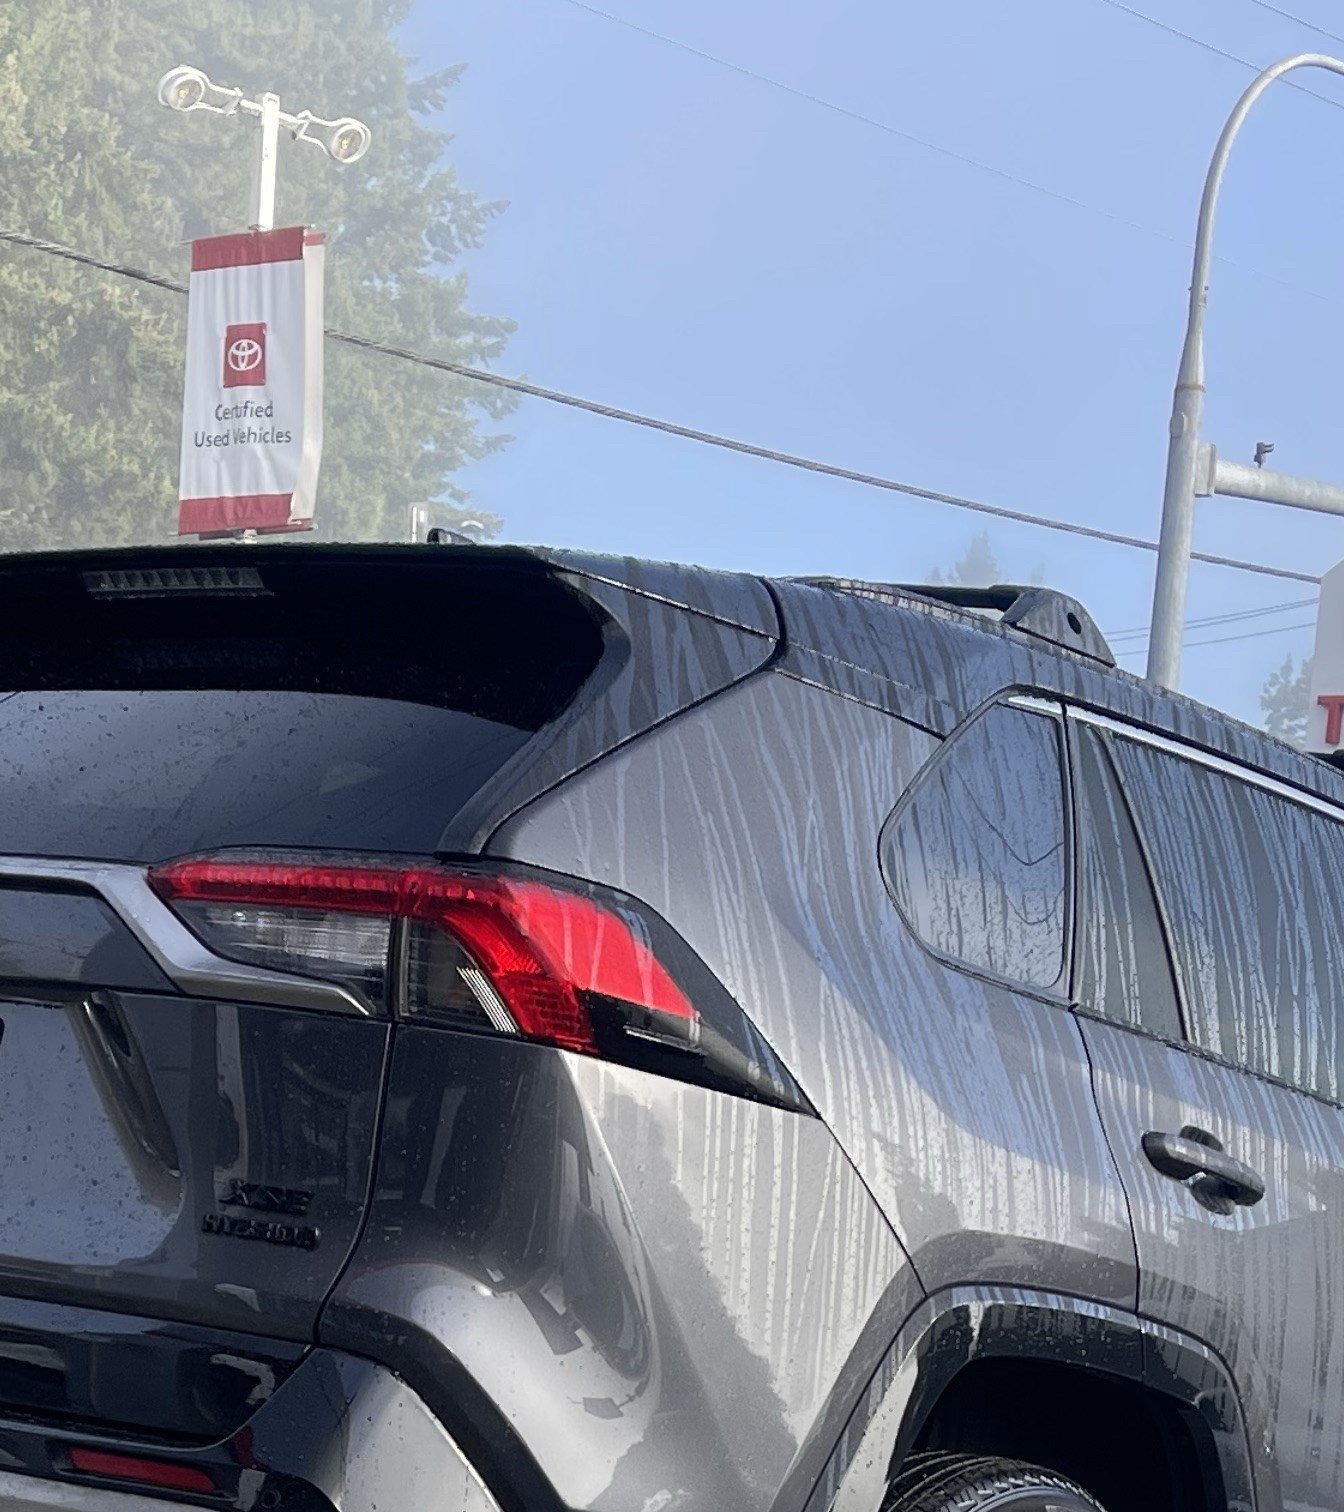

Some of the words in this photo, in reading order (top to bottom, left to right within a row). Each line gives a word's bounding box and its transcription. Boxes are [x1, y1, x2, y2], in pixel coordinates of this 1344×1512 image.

[214, 399, 274, 422] Certified
[194, 430, 229, 449] Used
[232, 427, 292, 446] Vehicles
